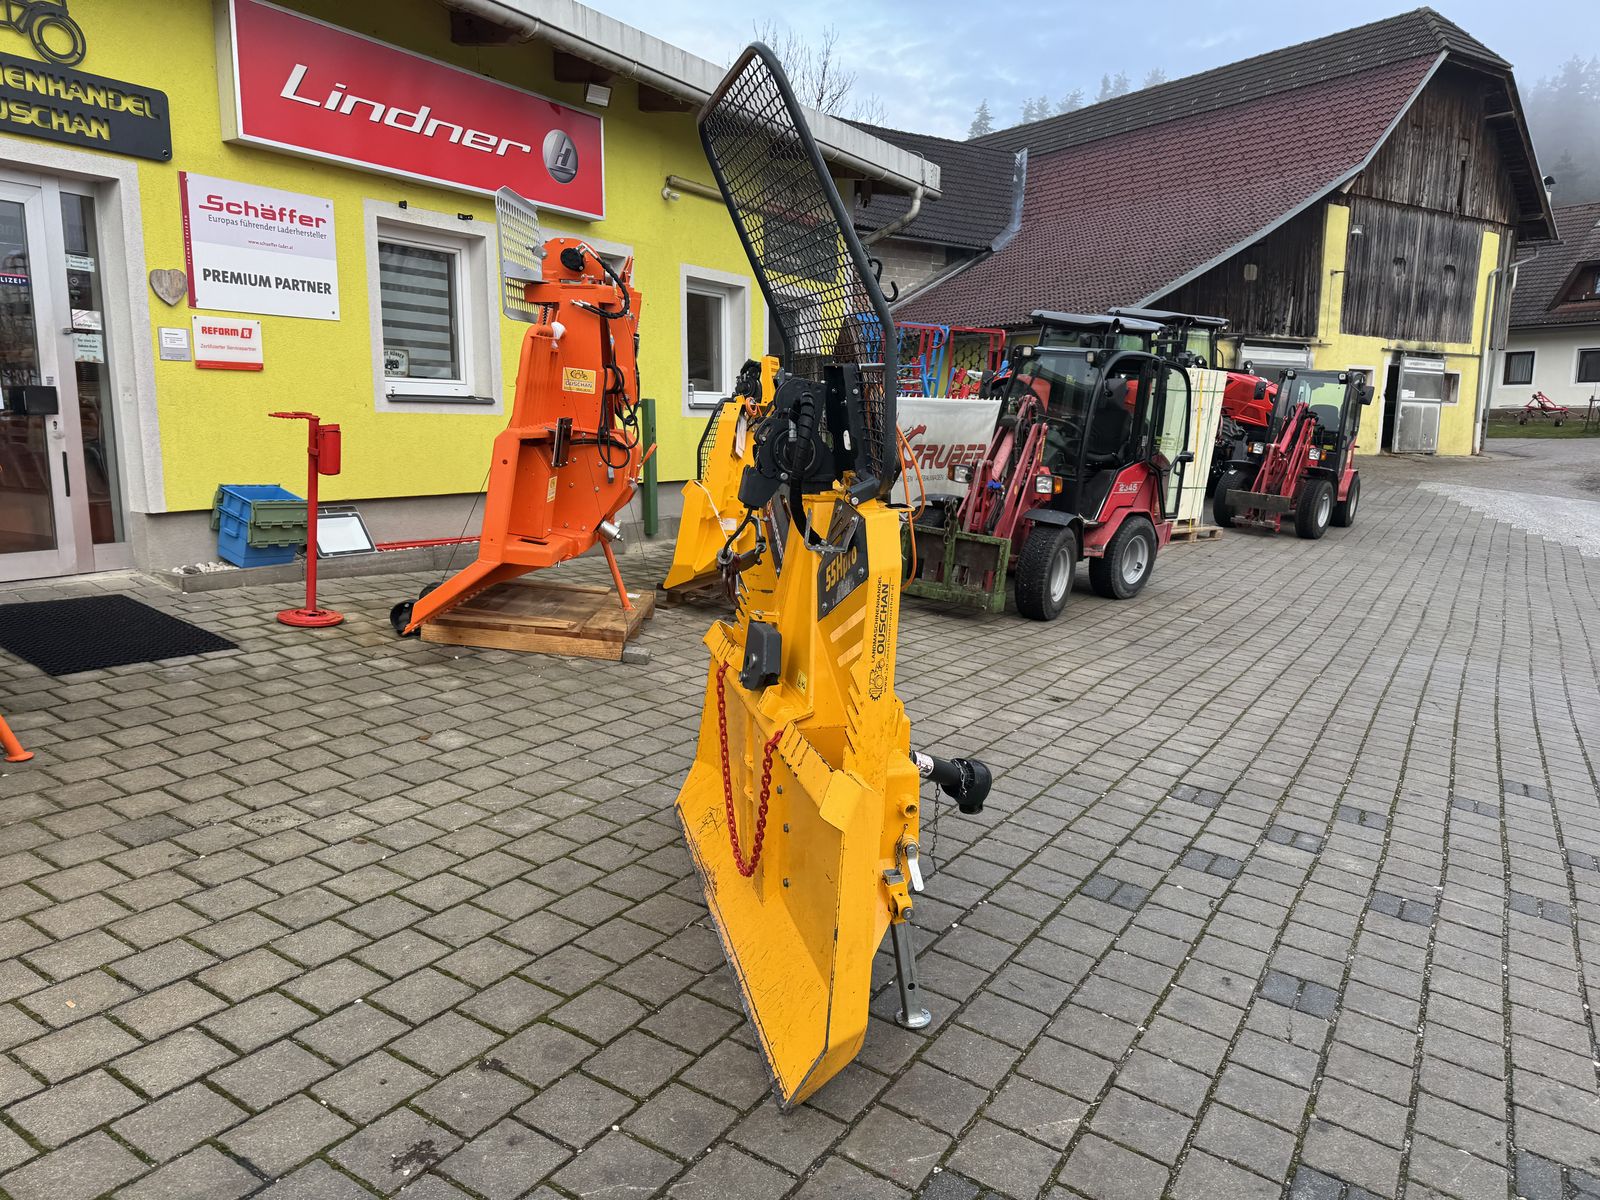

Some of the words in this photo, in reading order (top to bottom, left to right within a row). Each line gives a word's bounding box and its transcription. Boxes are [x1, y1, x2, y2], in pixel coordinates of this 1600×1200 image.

[0, 63, 161, 120] ENHANDEL
[279, 63, 532, 157] Lindner
[198, 194, 327, 229] Schäffer
[208, 214, 238, 227] Europas
[239, 218, 276, 232] führender
[277, 225, 328, 240] Laderhersteller
[202, 268, 272, 288] PREMIUM
[275, 276, 332, 295] PARTNER
[201, 326, 239, 337] REFORM
[871, 575, 883, 663] LANDMASCHINENHANDEL
[876, 583, 889, 655] OUSCHAN
